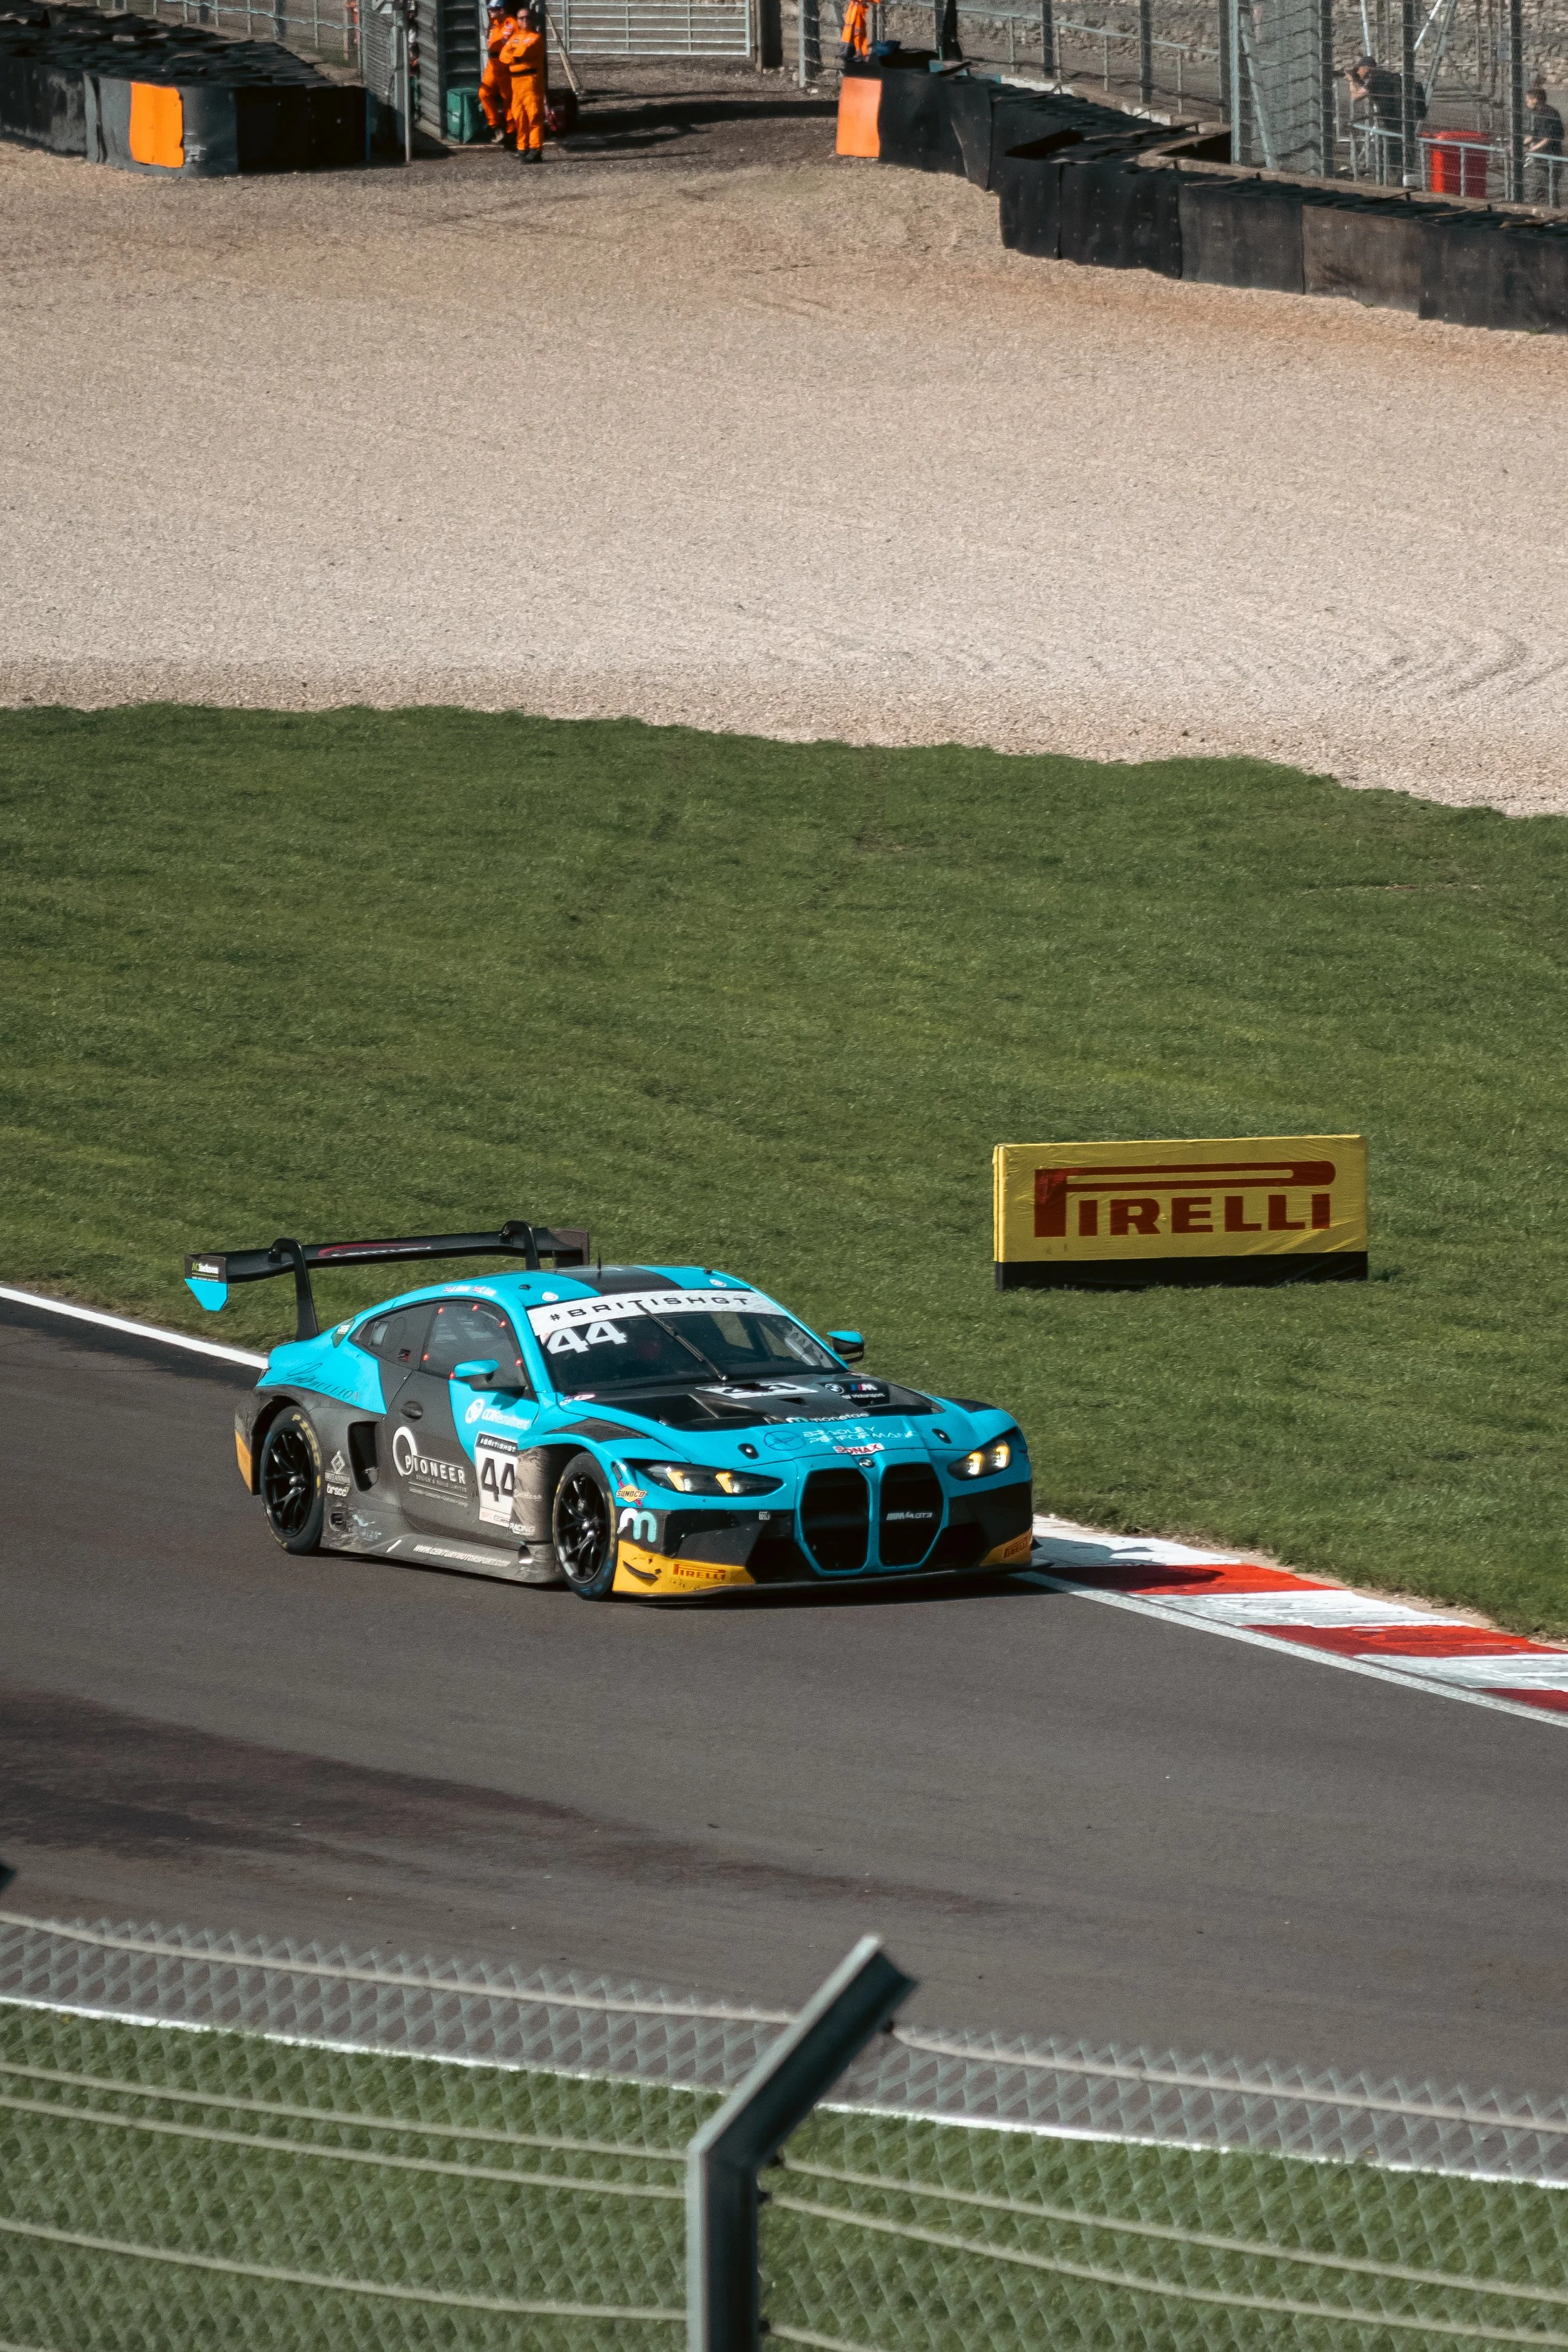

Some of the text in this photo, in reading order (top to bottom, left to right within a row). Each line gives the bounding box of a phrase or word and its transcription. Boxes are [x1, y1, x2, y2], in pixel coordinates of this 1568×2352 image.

[1034, 1161, 1336, 1237] PIRELLI
[549, 1296, 748, 1322] #BRITISHGT
[547, 1320, 627, 1355] 44
[803, 1427, 875, 1437] BRADLEY
[835, 1444, 879, 1454] SONAX
[405, 1455, 466, 1485] PIONEER
[674, 1564, 726, 1580] PIRELLI
